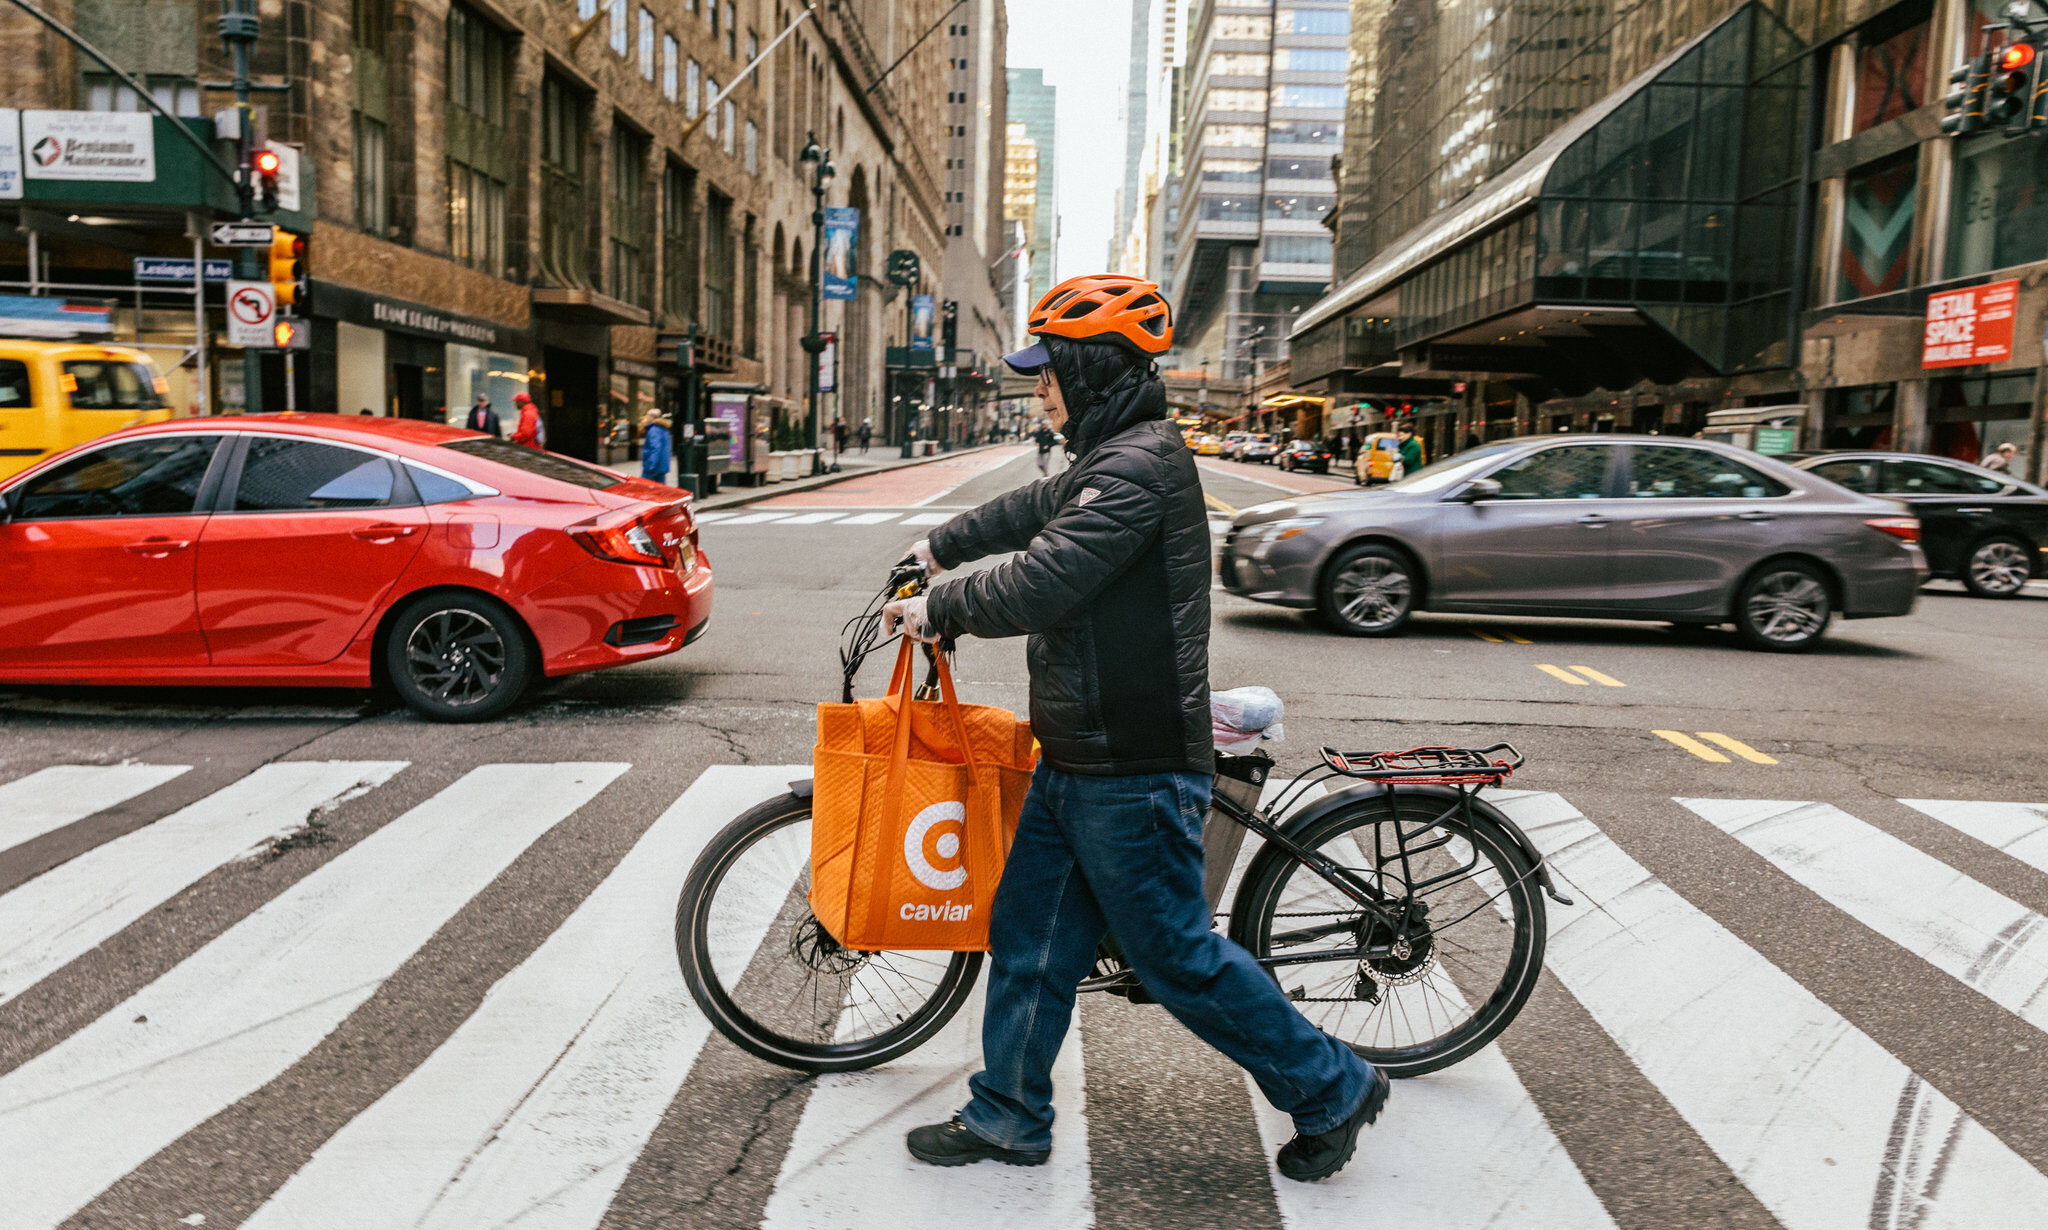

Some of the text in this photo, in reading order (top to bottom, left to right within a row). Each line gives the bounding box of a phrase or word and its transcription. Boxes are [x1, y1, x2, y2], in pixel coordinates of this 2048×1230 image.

[136, 261, 199, 279] Lexingto
[1926, 292, 1977, 321] RETAIL
[1925, 316, 1977, 346] SPACE
[900, 900, 972, 921] caviar
